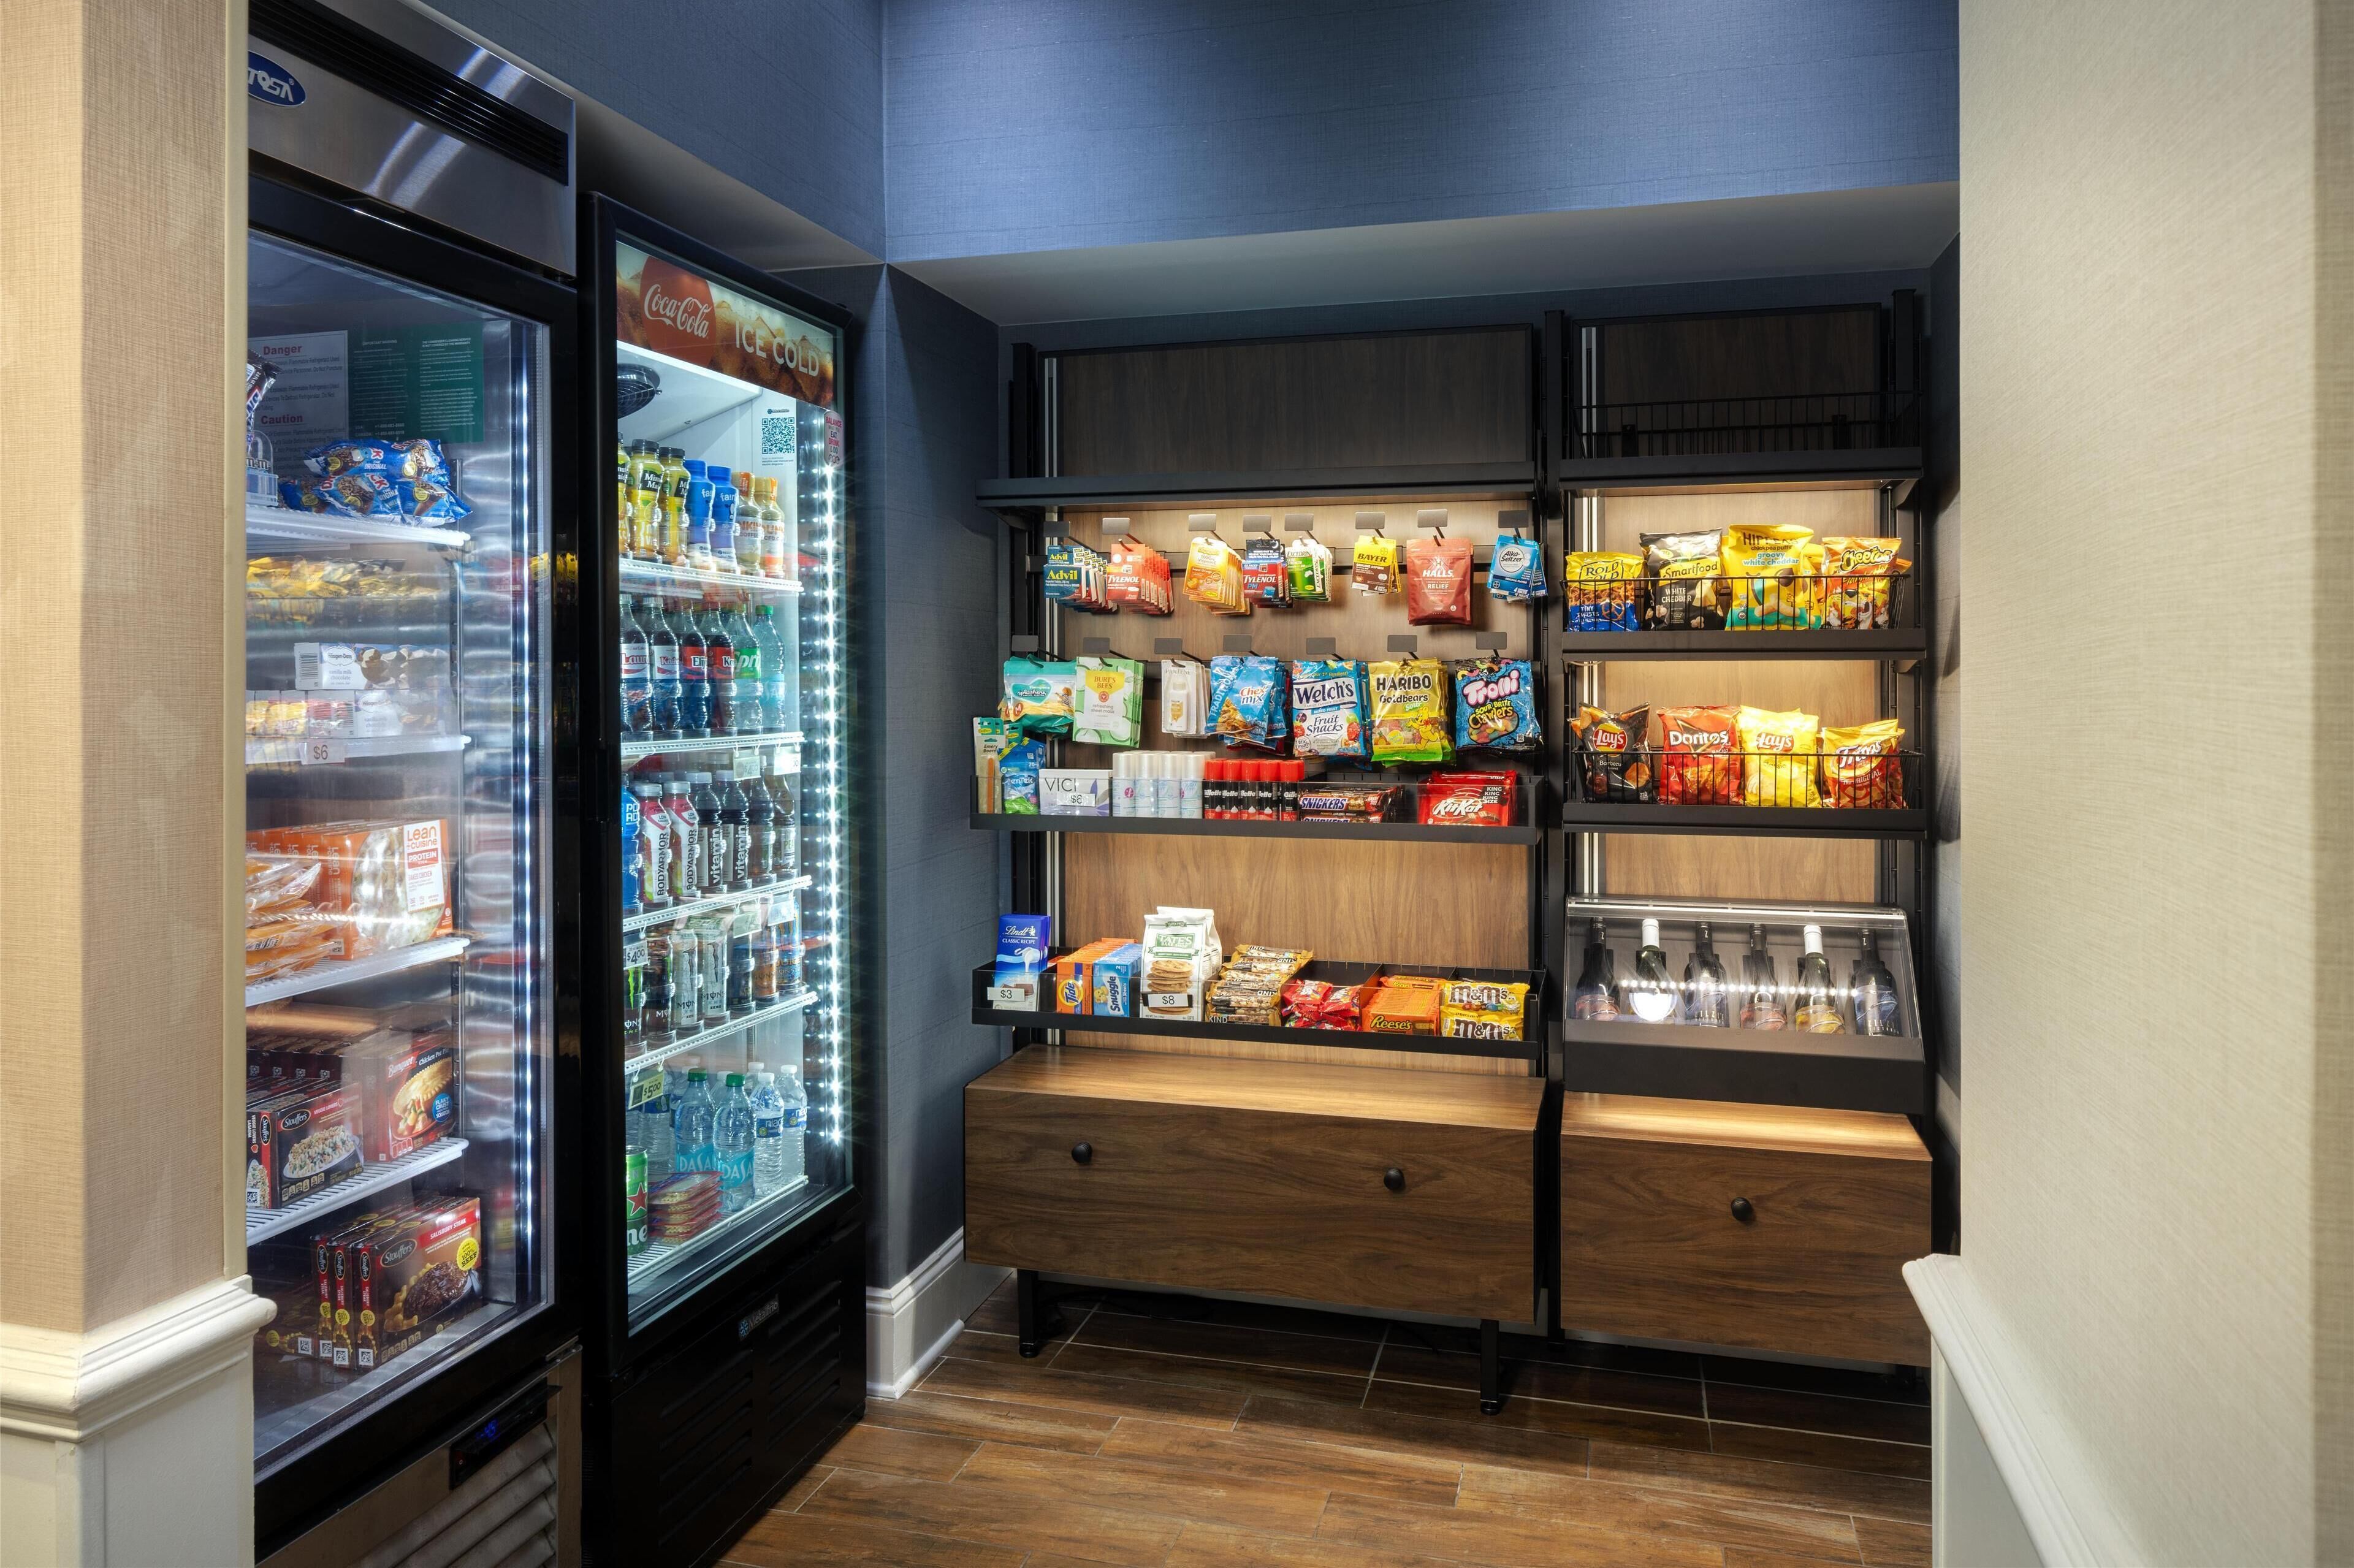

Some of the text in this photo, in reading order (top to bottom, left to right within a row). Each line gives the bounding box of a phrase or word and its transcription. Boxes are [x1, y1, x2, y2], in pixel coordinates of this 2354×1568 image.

[644, 283, 712, 338] Coca-Cola
[263, 345, 303, 357] Danger
[736, 322, 820, 377] ICE COLD
[261, 414, 303, 424] Caution
[1357, 553, 1387, 563] BAYER
[1840, 546, 1893, 571] Cheetos
[1046, 569, 1078, 580] Advil
[1585, 560, 1620, 576] ROLD
[1663, 560, 1718, 579] Smartfood
[1107, 574, 1140, 584] TYLENOL
[1243, 575, 1277, 584] TYLENOL
[1376, 674, 1432, 691] HARIBO
[1463, 669, 1520, 705] Trolli
[1240, 686, 1267, 697] Chex
[1241, 694, 1264, 704] mix
[1294, 680, 1354, 704] Welch's
[1379, 693, 1428, 704] Goldbears
[1015, 704, 1021, 715] M
[1475, 699, 1511, 714] SOUR BRITE
[1314, 714, 1339, 726] Fruit
[1469, 705, 1514, 729] Crawlers
[1306, 723, 1344, 736] Snacks
[1596, 729, 1625, 749] Lay's
[1669, 730, 1729, 746] Doritos
[1758, 732, 1793, 752] Lay's
[313, 744, 328, 760] $6
[1835, 740, 1882, 769] Fritos
[1006, 777, 1034, 785] enTek
[1044, 777, 1077, 793] VICI
[1070, 794, 1083, 804] $6
[1300, 796, 1347, 810] SNICKERS
[1433, 799, 1484, 816] KitKat
[407, 826, 437, 842] Lean
[408, 850, 437, 862] PROTEIN
[710, 828, 722, 883] vitamin
[735, 824, 746, 879] vitamin
[657, 832, 667, 896] BODYARMOR
[687, 829, 695, 891] BODYARMOR
[1004, 925, 1029, 937] Lindt
[1159, 935, 1192, 945] TATE'S
[1000, 989, 1013, 1000] $3
[1064, 981, 1079, 1003] Tide
[1110, 976, 1121, 1012] Snuggle
[1162, 995, 1175, 1005] $8
[1450, 984, 1509, 1004] m&m's
[1370, 1015, 1412, 1030] Reese's
[1453, 1018, 1510, 1039] m&m's
[419, 1055, 435, 1066] Chicken
[435, 1096, 449, 1106] FLAKY
[435, 1102, 449, 1111] CRUST
[284, 1113, 308, 1127] Stouffer's
[436, 1109, 450, 1119] SCRATCH
[430, 1217, 467, 1239] SALISBURY STEAK
[384, 1243, 413, 1264] Stouffer's
[461, 1251, 478, 1268] BEEF
[748, 1301, 779, 1331] Metalfrio
